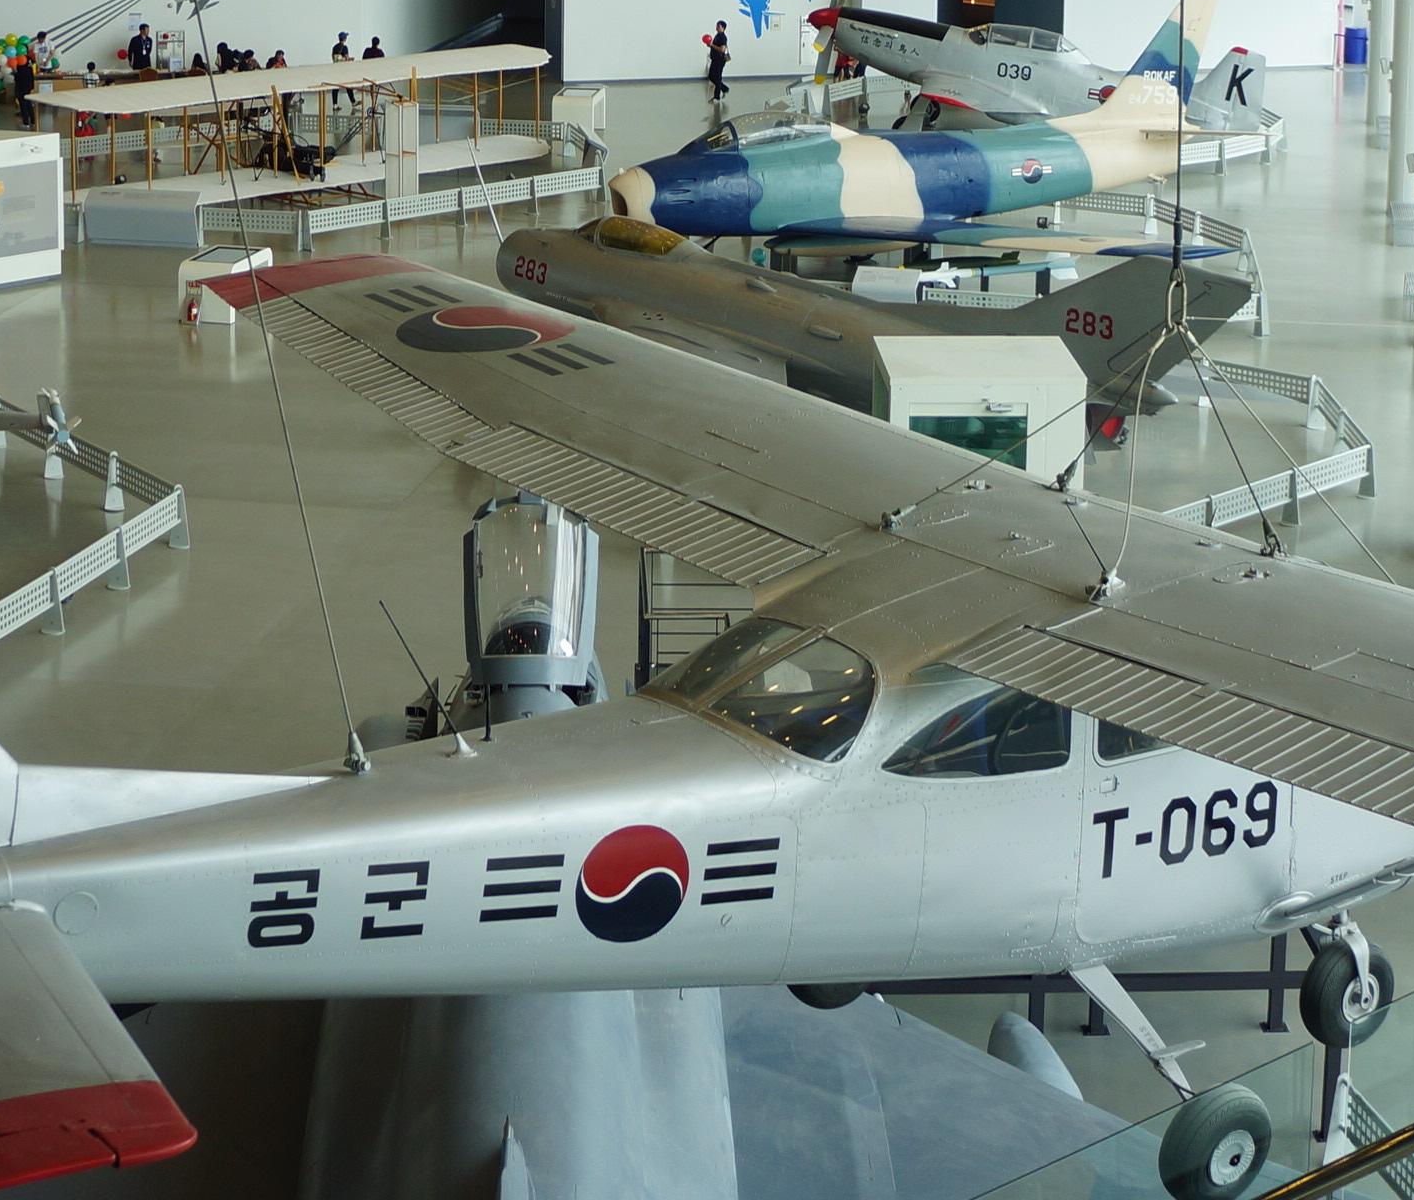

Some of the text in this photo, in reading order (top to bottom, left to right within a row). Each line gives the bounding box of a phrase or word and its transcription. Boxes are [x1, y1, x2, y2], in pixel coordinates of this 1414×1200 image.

[997, 62, 1032, 81] 039
[1143, 69, 1176, 82] ROKAF
[1225, 63, 1254, 107] K
[514, 255, 548, 285] 283
[1066, 307, 1115, 341] 283
[1092, 780, 1278, 879] T-069
